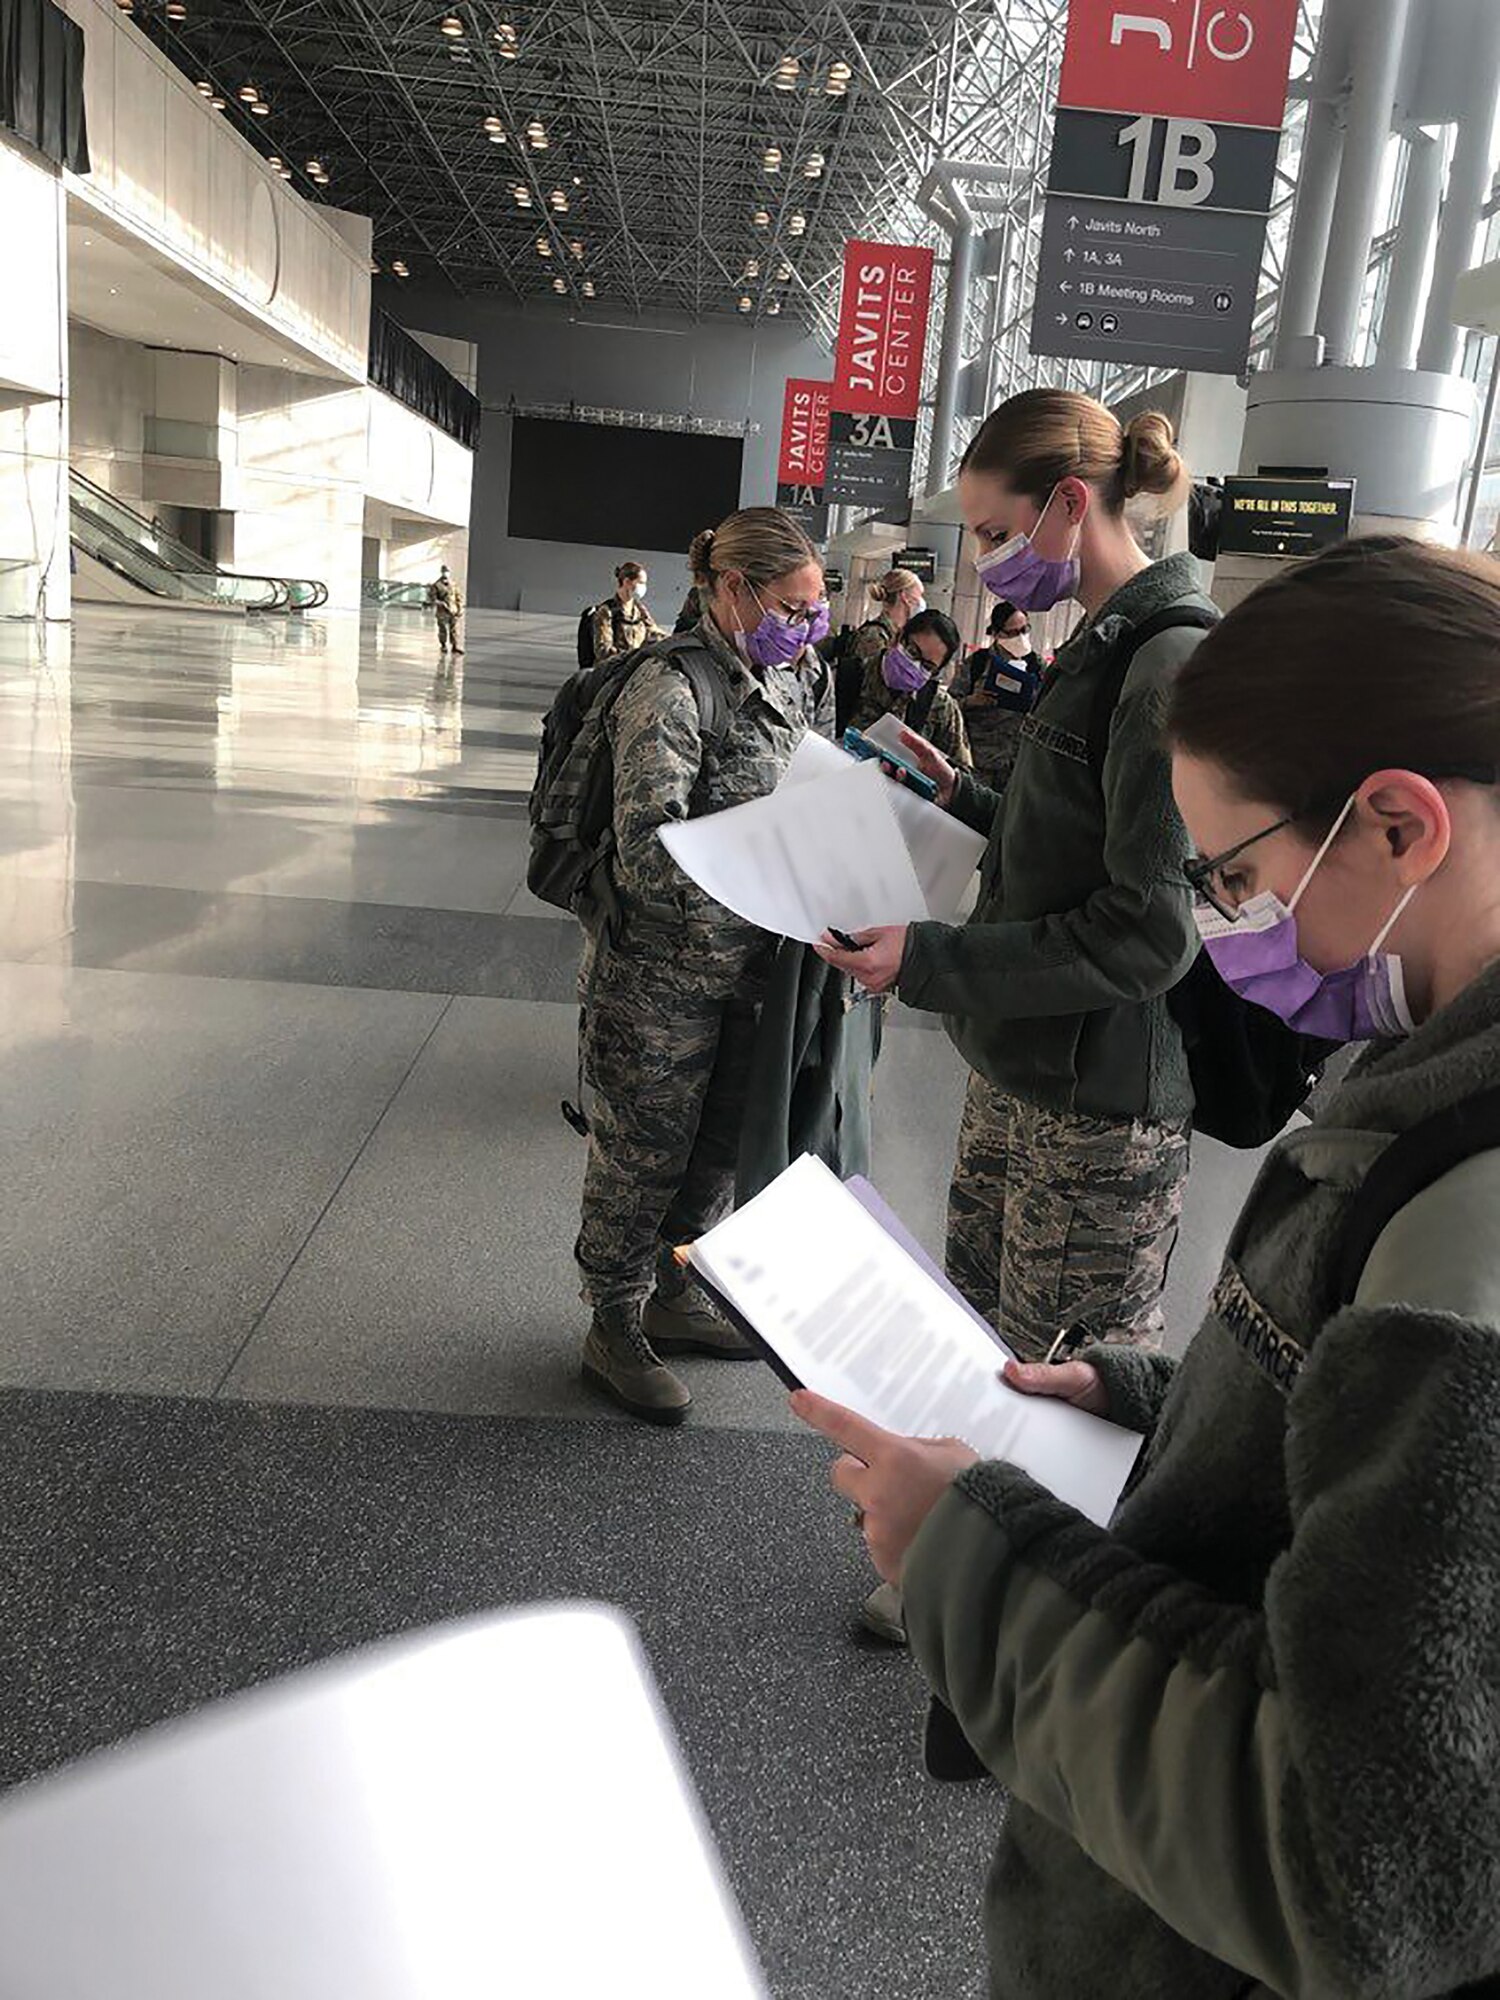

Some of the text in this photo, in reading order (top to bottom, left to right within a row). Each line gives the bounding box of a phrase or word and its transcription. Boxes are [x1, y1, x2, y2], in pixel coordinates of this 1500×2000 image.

[1118, 116, 1217, 205] 1B
[1085, 218, 1161, 237] Javits North
[1105, 253, 1123, 266] 3A
[1080, 283, 1194, 305] 1B Meeting Rooms
[849, 266, 885, 390] JAVITS
[886, 268, 916, 394] CENTER
[788, 392, 810, 470] JAVITS
[811, 394, 829, 473] CENTER
[849, 413, 895, 449] 3A
[790, 484, 816, 505] 1A
